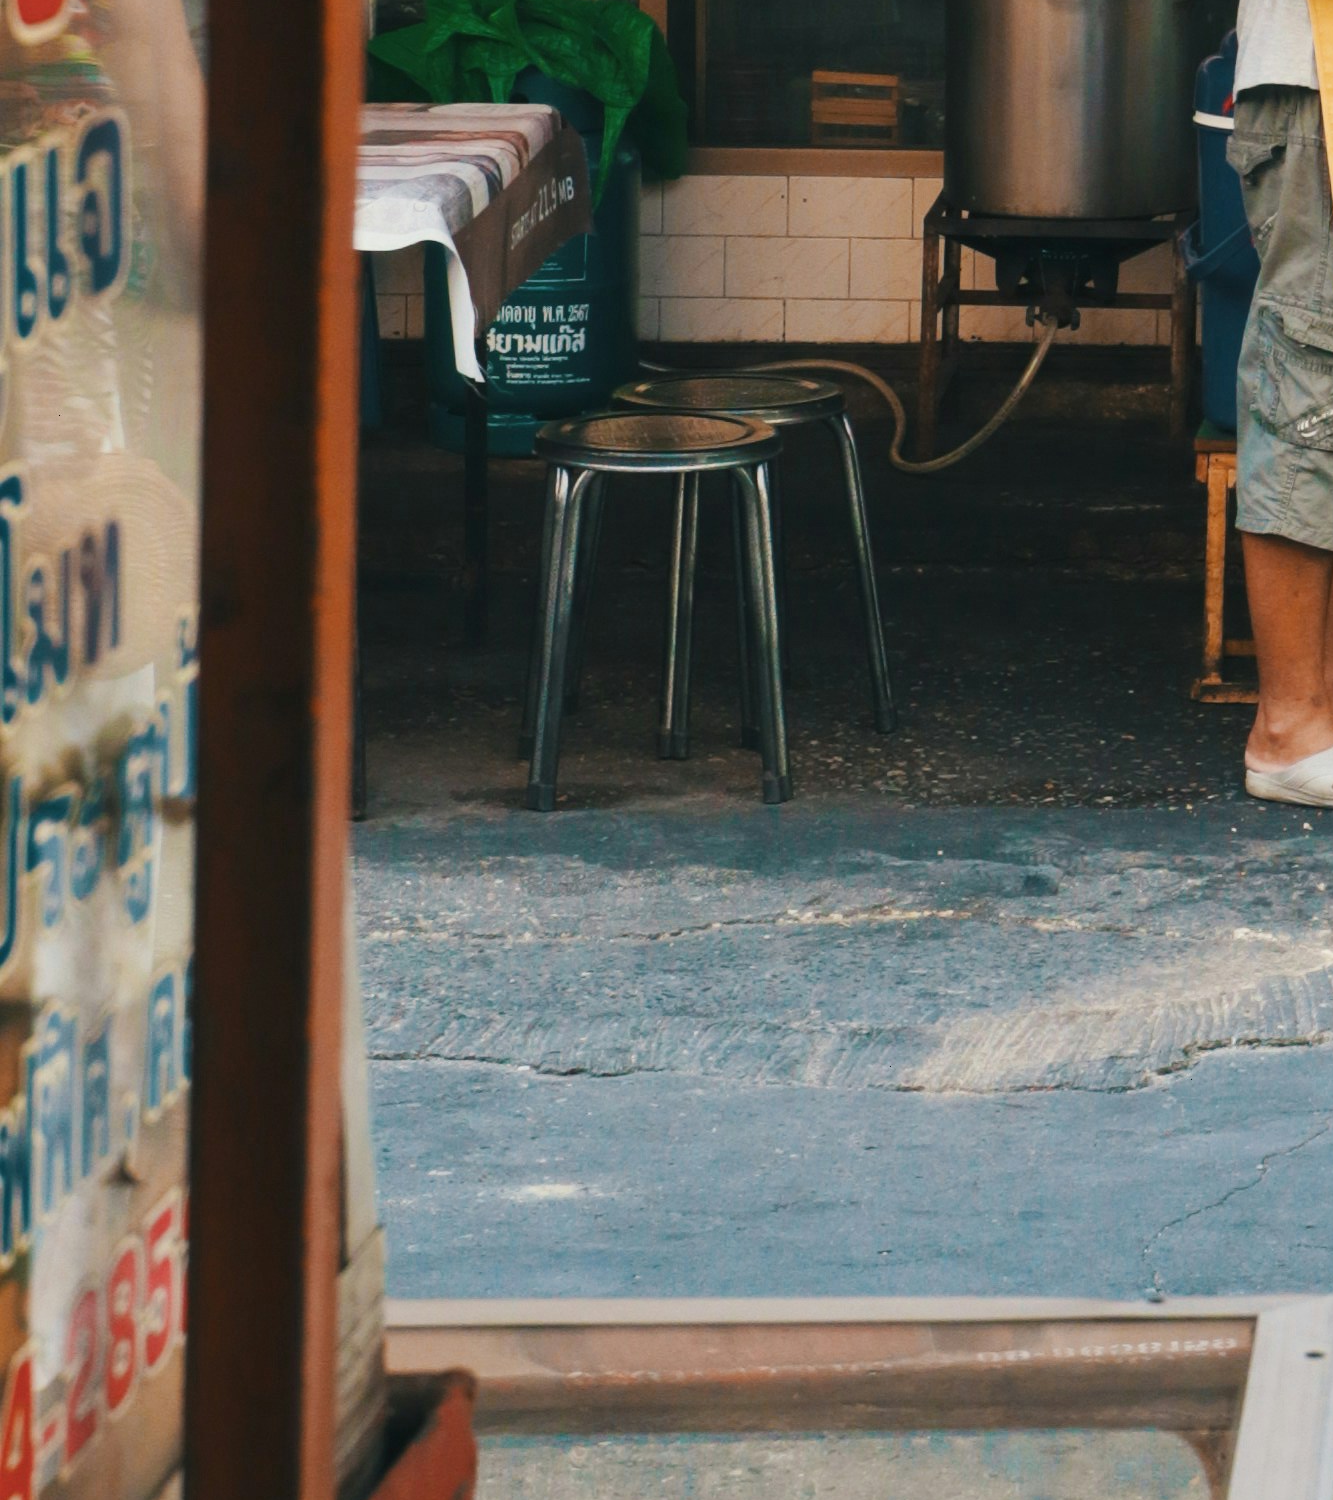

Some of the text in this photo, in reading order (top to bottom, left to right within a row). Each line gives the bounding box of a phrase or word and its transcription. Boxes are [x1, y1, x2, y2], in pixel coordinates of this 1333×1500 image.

[558, 176, 575, 204] MB
[486, 323, 587, 355] สยามแก๊ส
